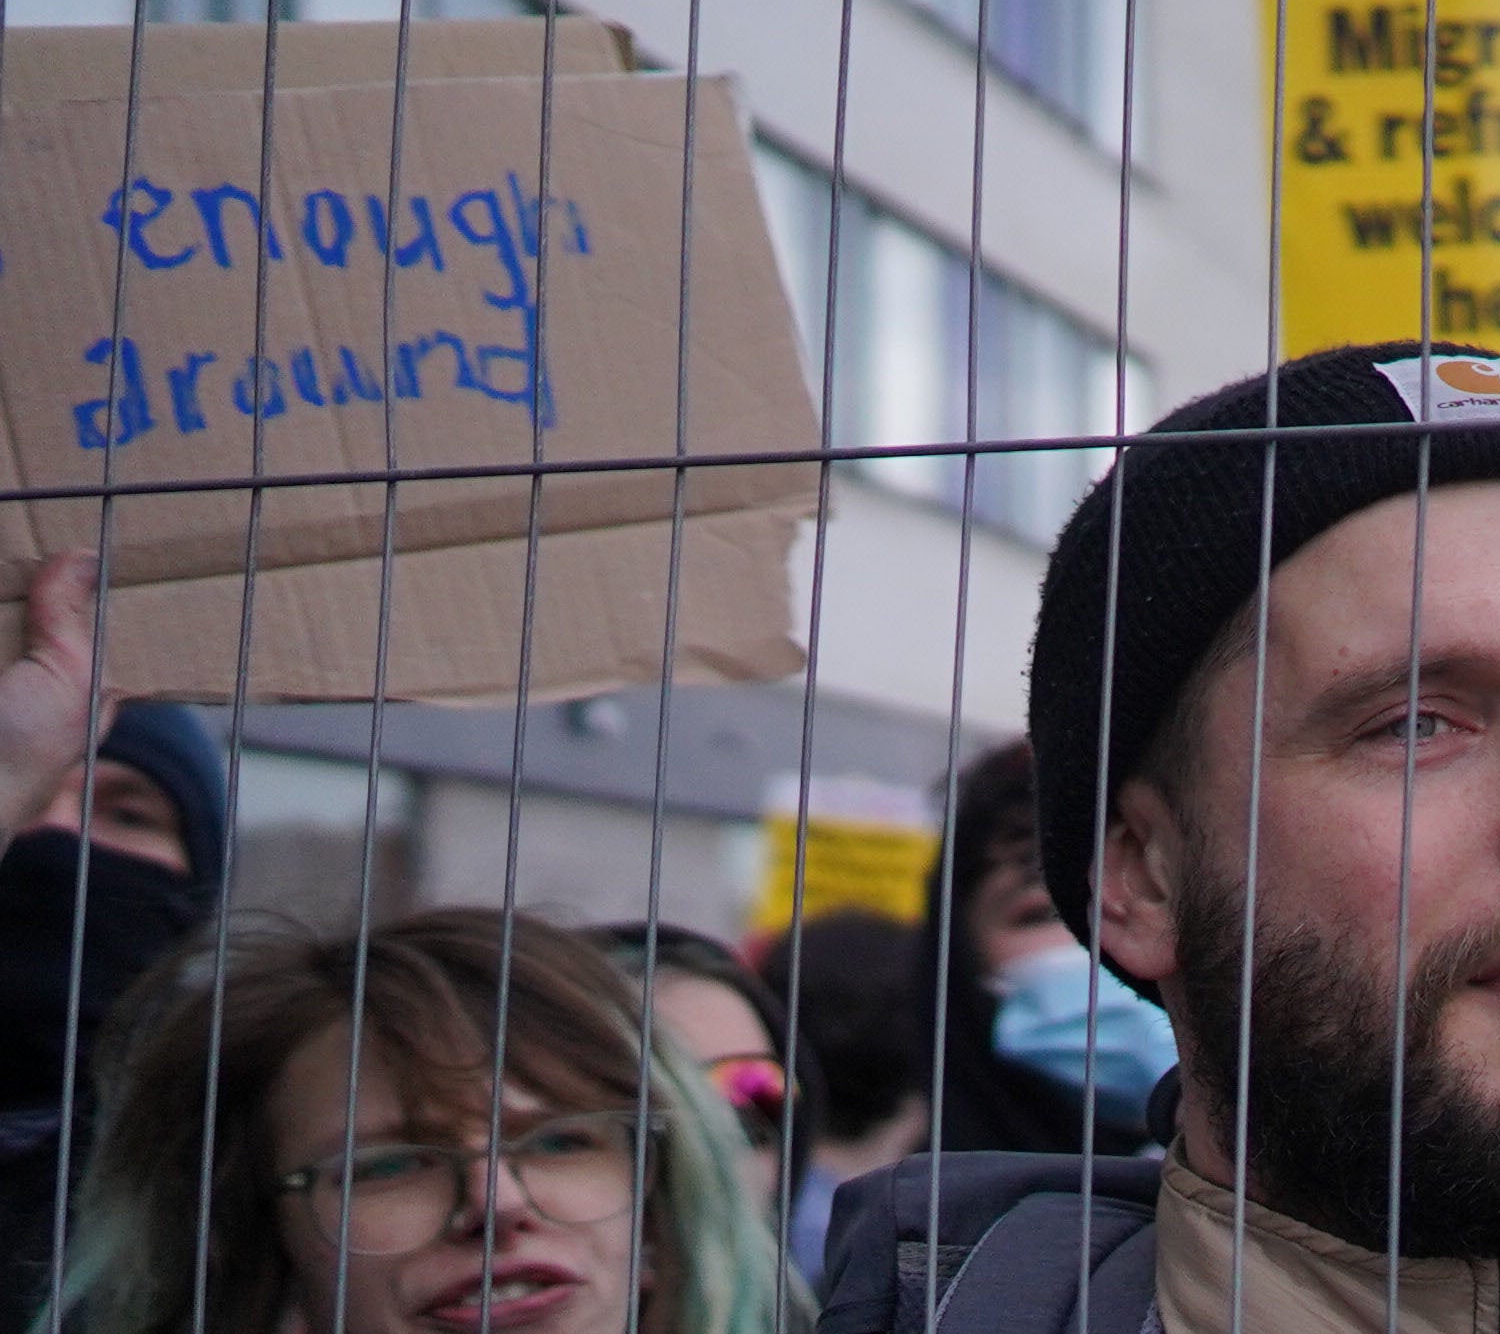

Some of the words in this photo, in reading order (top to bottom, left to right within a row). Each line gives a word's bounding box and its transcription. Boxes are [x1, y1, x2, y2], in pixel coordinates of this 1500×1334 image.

[1293, 94, 1351, 166] &
[102, 171, 592, 311] enough
[72, 303, 558, 451] around
